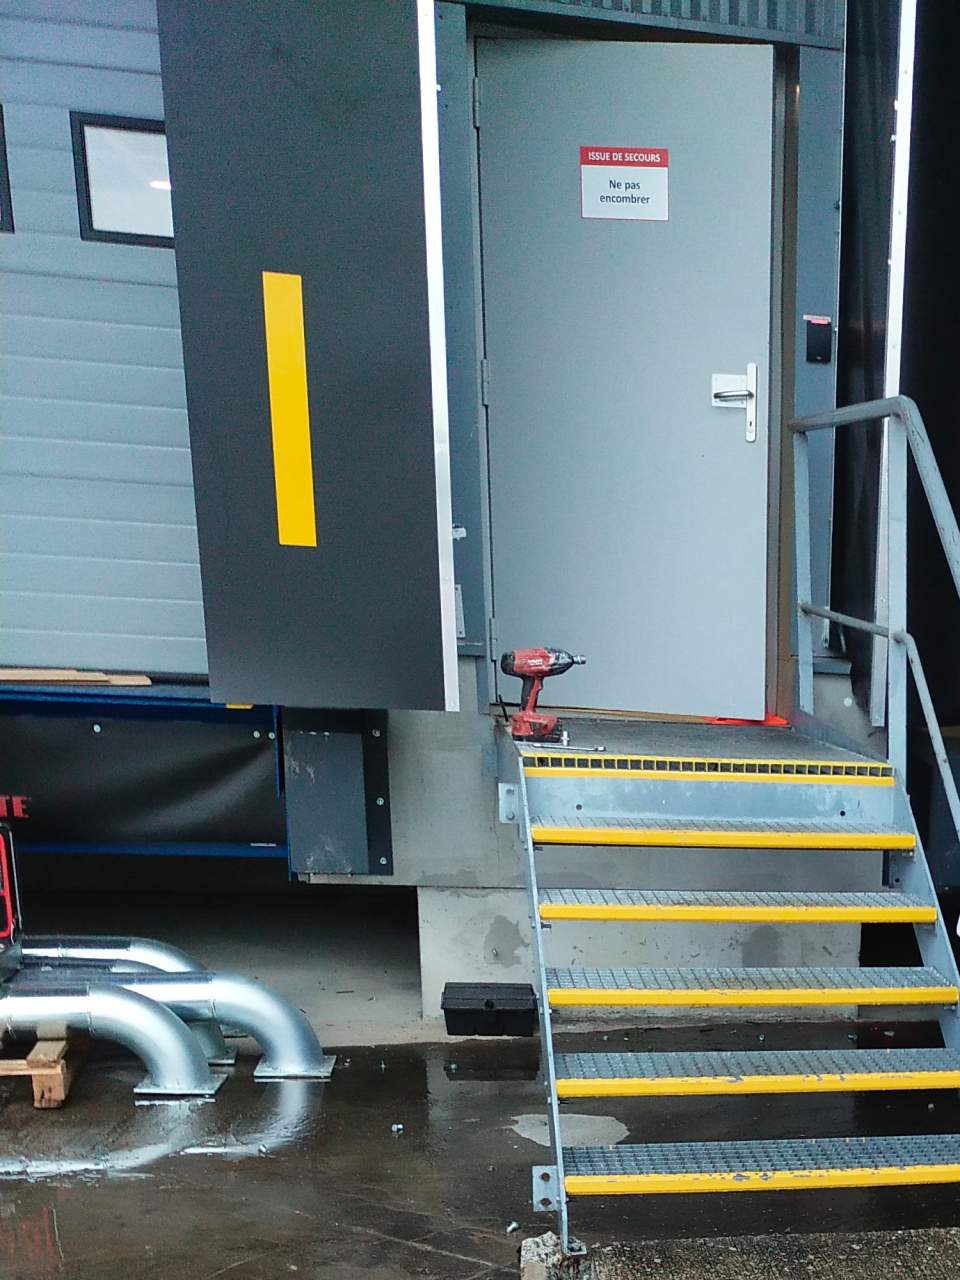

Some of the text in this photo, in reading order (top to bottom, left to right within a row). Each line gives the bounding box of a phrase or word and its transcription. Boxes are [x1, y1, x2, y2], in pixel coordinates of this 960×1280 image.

[588, 151, 661, 163] ISSUE DE SECOURS
[609, 180, 641, 191] Ne pas
[599, 194, 651, 204] encombrer
